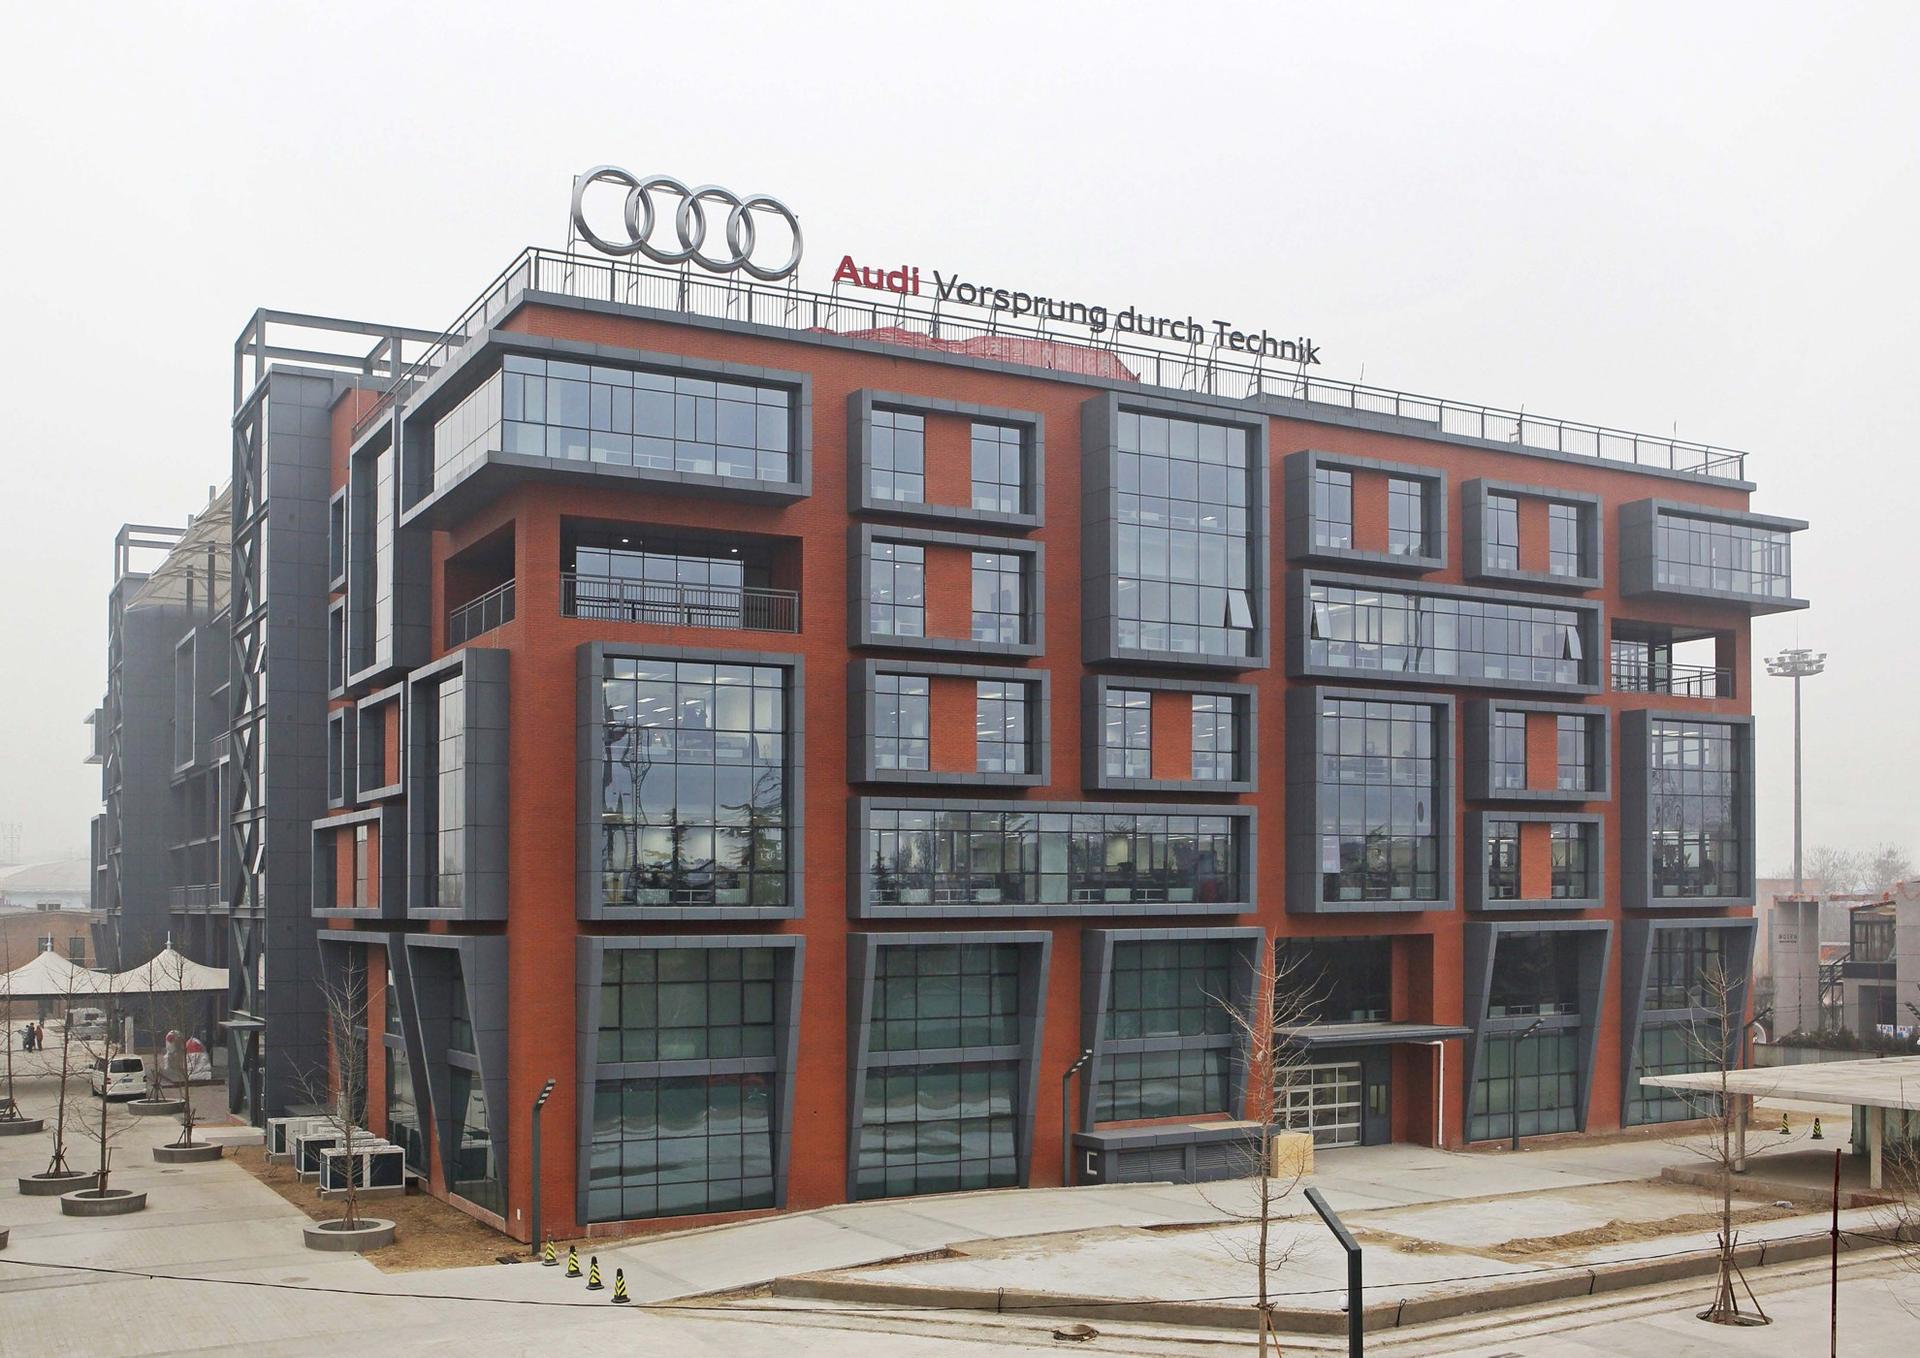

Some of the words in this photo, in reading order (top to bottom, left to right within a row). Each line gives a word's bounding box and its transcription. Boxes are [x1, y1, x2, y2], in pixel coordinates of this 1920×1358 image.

[833, 255, 919, 295] Audi
[933, 270, 1107, 333] Vorsprung
[1117, 305, 1204, 345] durch
[1212, 320, 1321, 365] Technik
